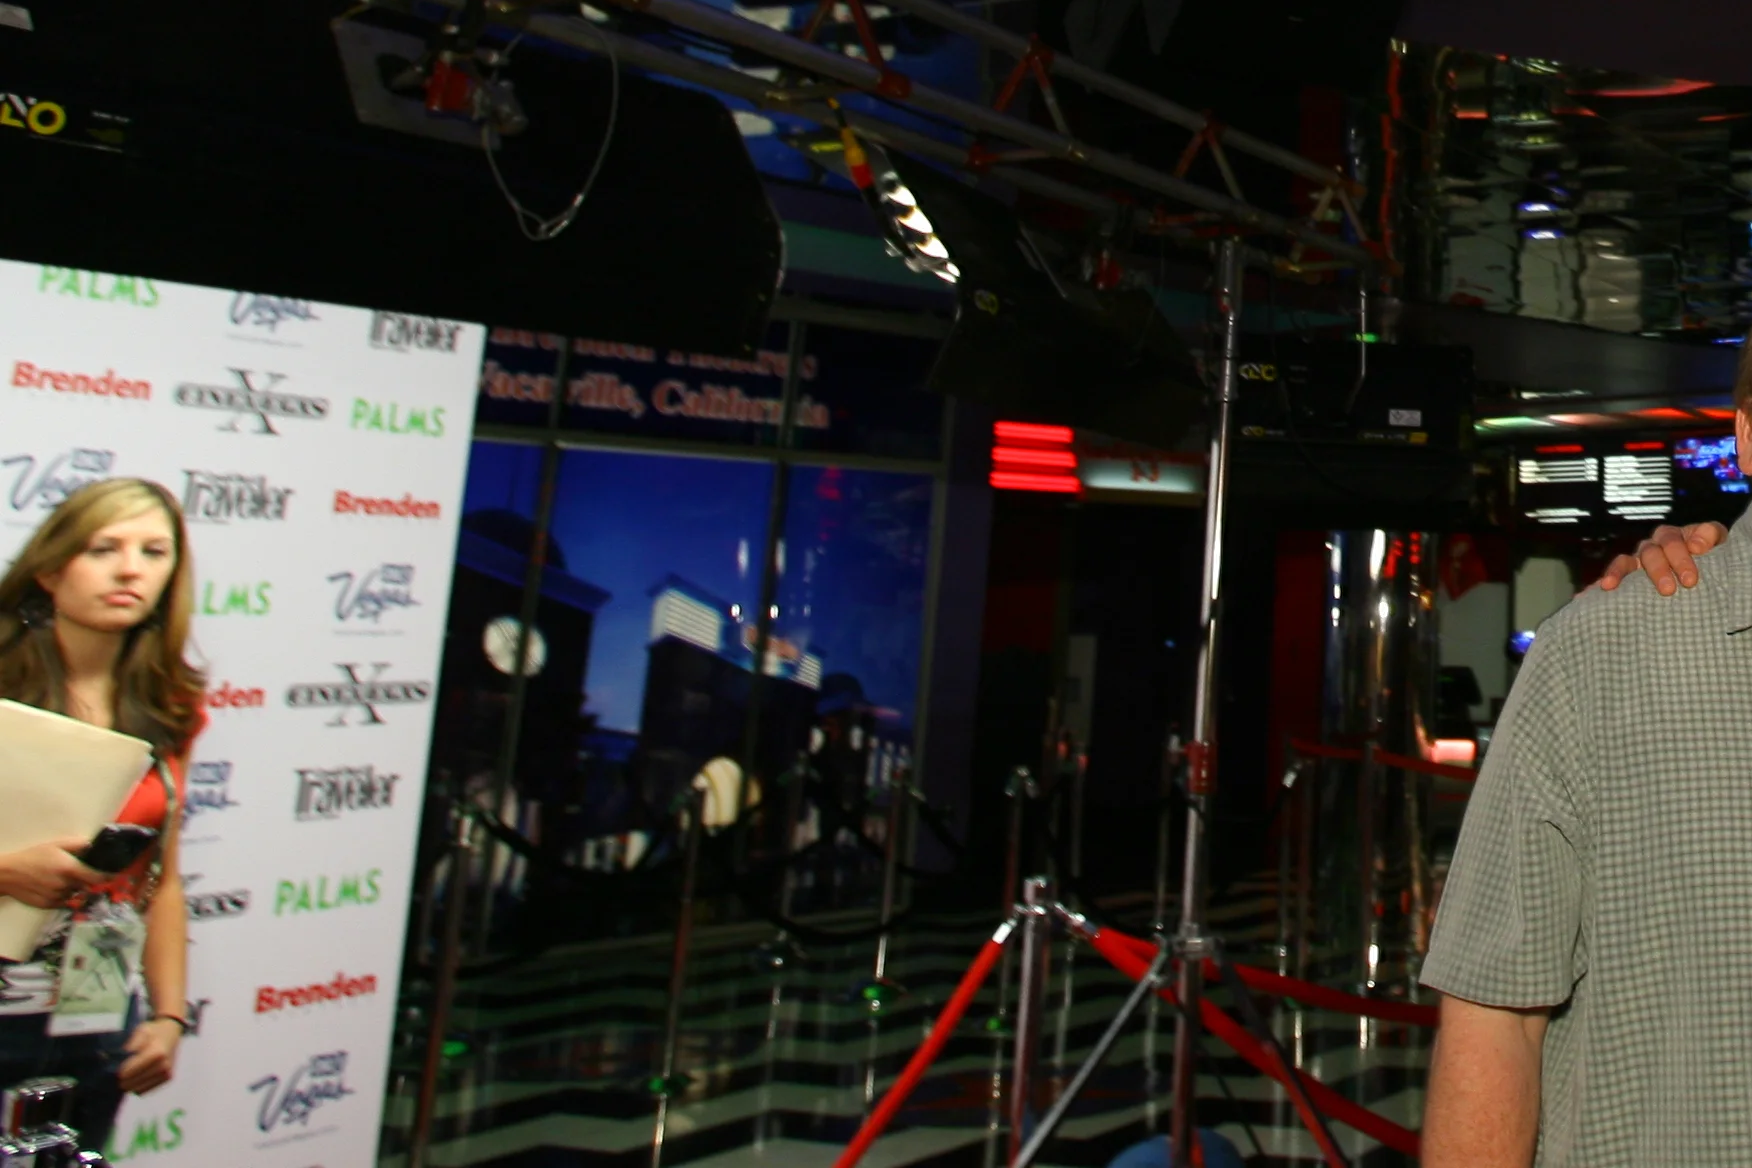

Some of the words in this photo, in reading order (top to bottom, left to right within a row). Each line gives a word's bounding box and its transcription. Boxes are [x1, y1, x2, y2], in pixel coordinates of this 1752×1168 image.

[10, 359, 153, 401] Brenden
[350, 397, 448, 437] PALMS
[332, 488, 442, 520] Brenden
[273, 867, 383, 917] PALMS
[253, 970, 379, 1014] Brenden
